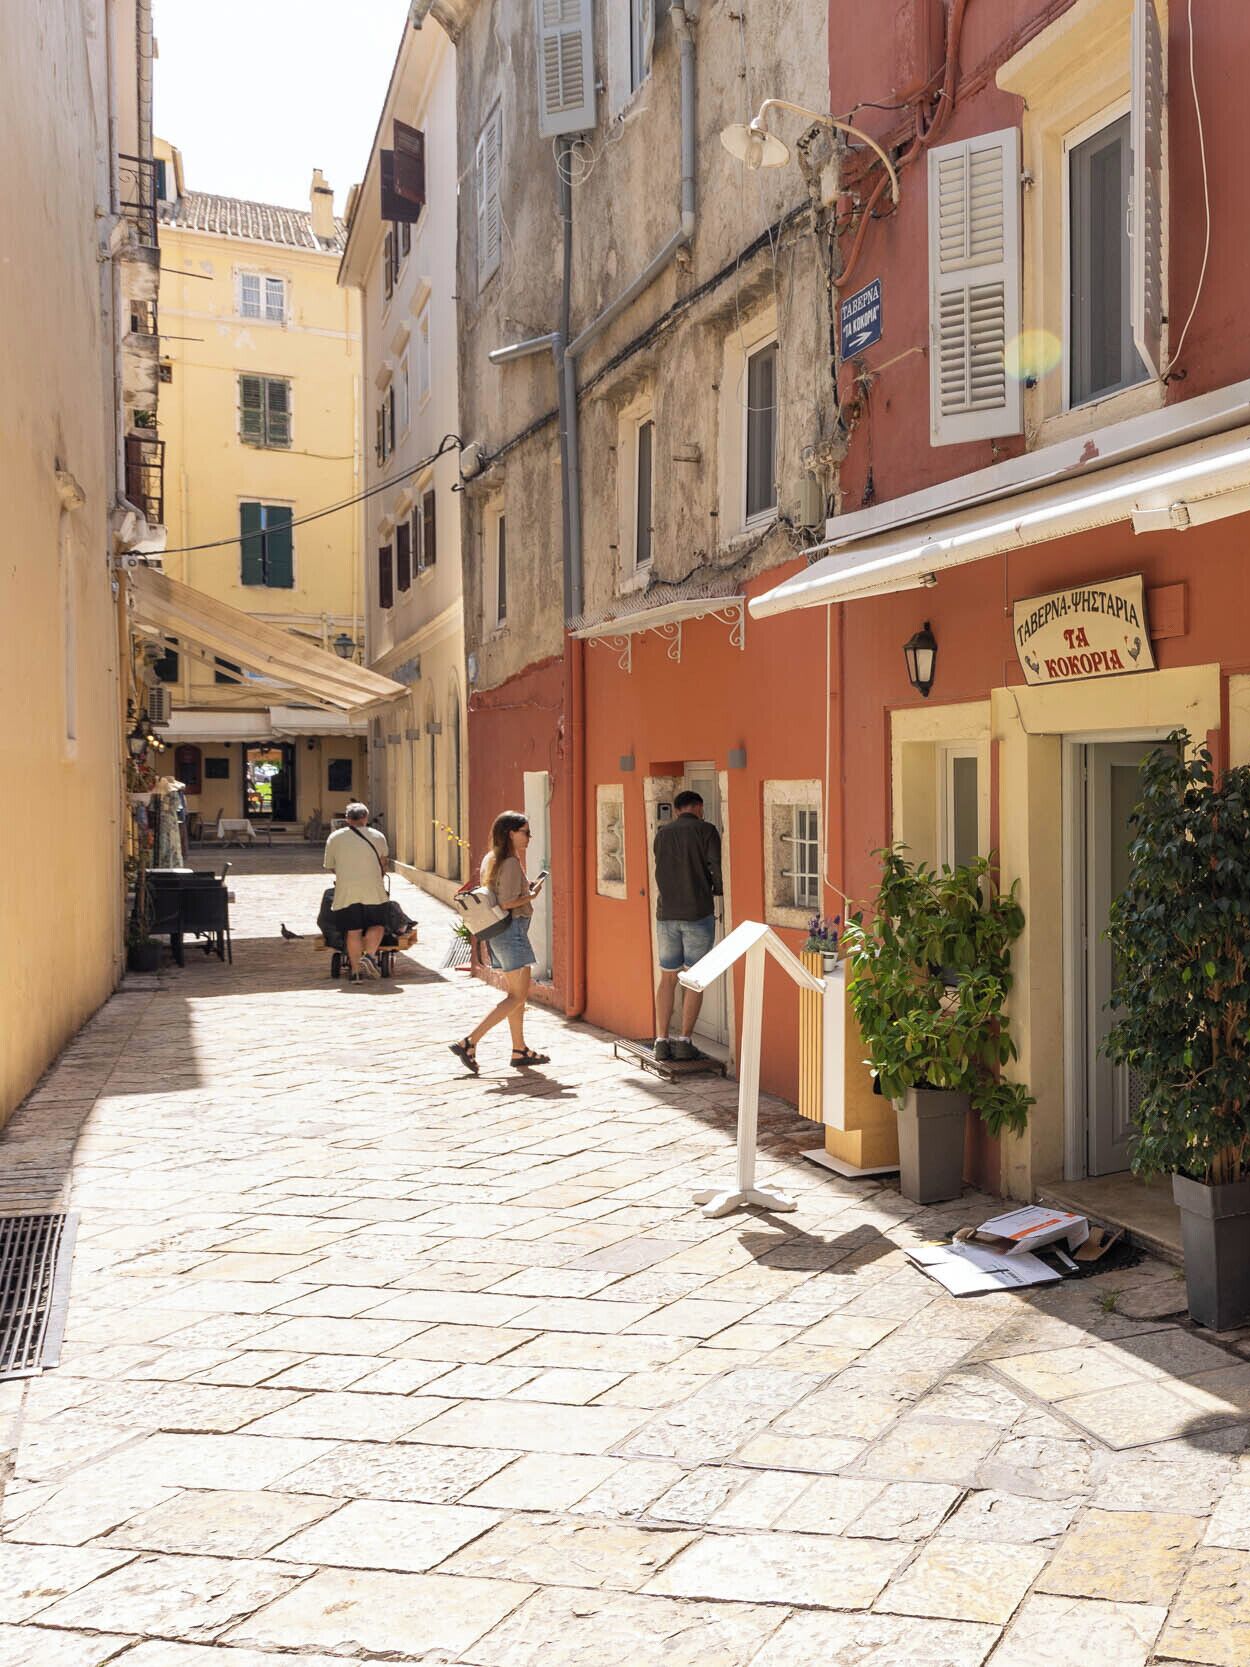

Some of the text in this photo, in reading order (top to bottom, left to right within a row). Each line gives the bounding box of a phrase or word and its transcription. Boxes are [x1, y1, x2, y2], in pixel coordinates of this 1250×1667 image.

[842, 285, 879, 321] ΤΑΒΕΡΝΑ
[1063, 624, 1090, 650] ΤΑ
[1044, 648, 1125, 679] ΚΟΚΟΡΙΑ
